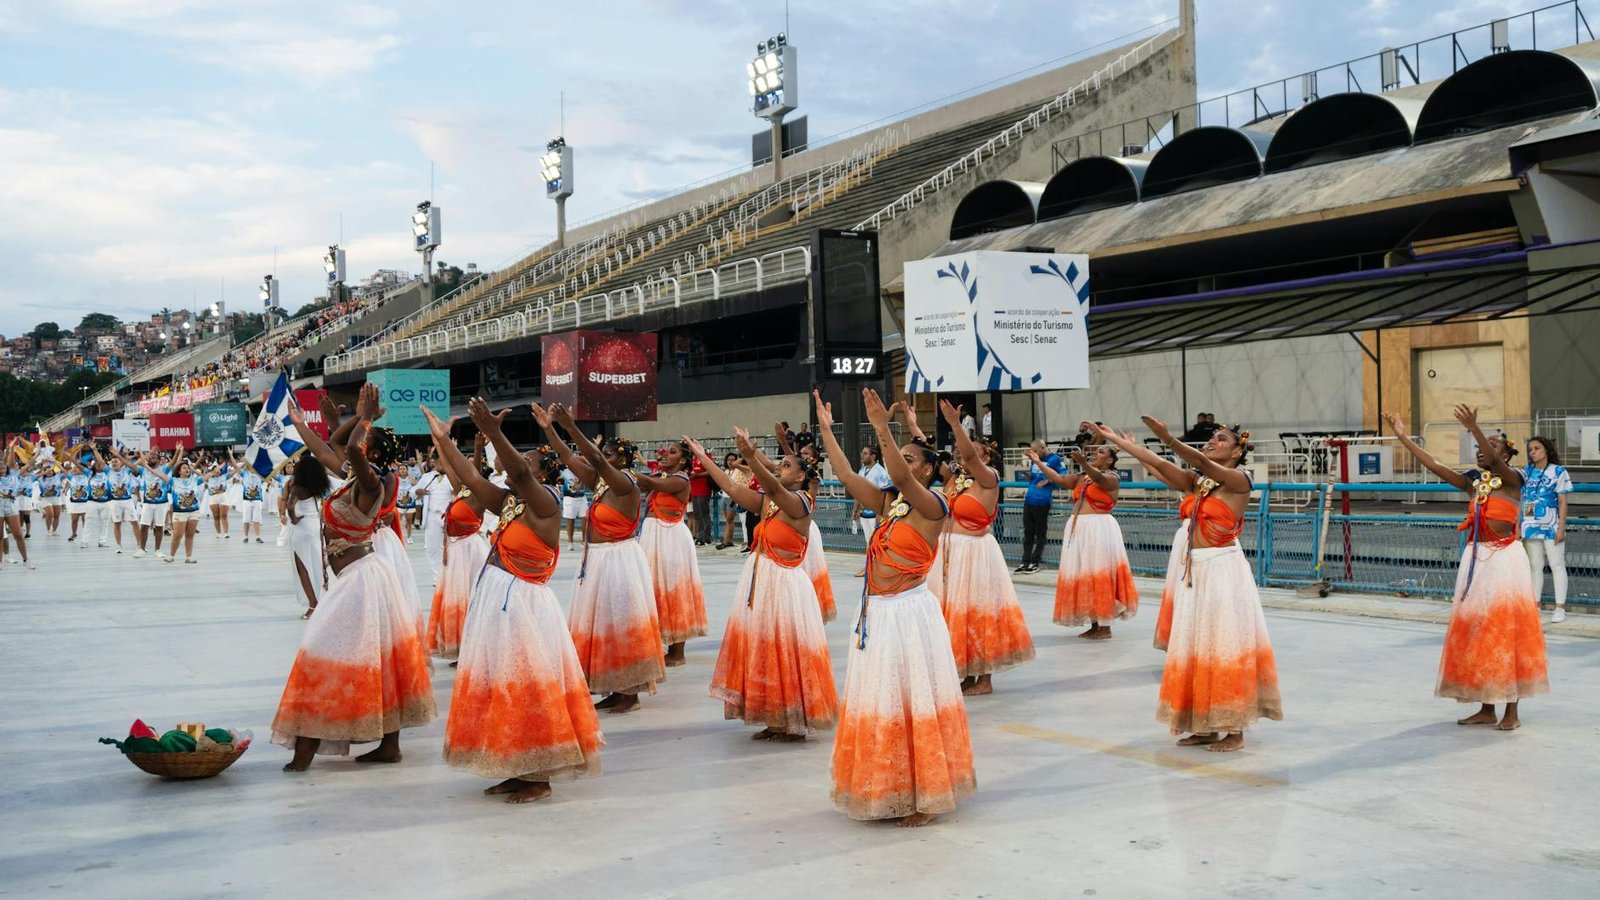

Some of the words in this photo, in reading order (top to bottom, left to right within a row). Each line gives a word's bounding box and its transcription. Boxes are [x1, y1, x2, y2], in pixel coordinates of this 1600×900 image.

[1025, 308, 1031, 316] de
[914, 324, 940, 335] Ministério
[940, 324, 946, 333] do
[946, 323, 966, 332] Turismo
[994, 319, 1032, 330] Ministério
[1033, 320, 1042, 330] do
[1043, 320, 1073, 330] Turismo
[925, 338, 937, 348] Sesc
[940, 337, 956, 347] Senac
[1010, 334, 1029, 344] Sesc
[1034, 334, 1057, 344] Senac
[833, 357, 852, 374] 18
[855, 357, 874, 374] 27
[545, 371, 573, 385] SUPERBET
[588, 371, 647, 385] SUPERBET
[419, 389, 447, 402] RIO
[220, 413, 238, 422] Light
[160, 427, 190, 437] BRAHMA
